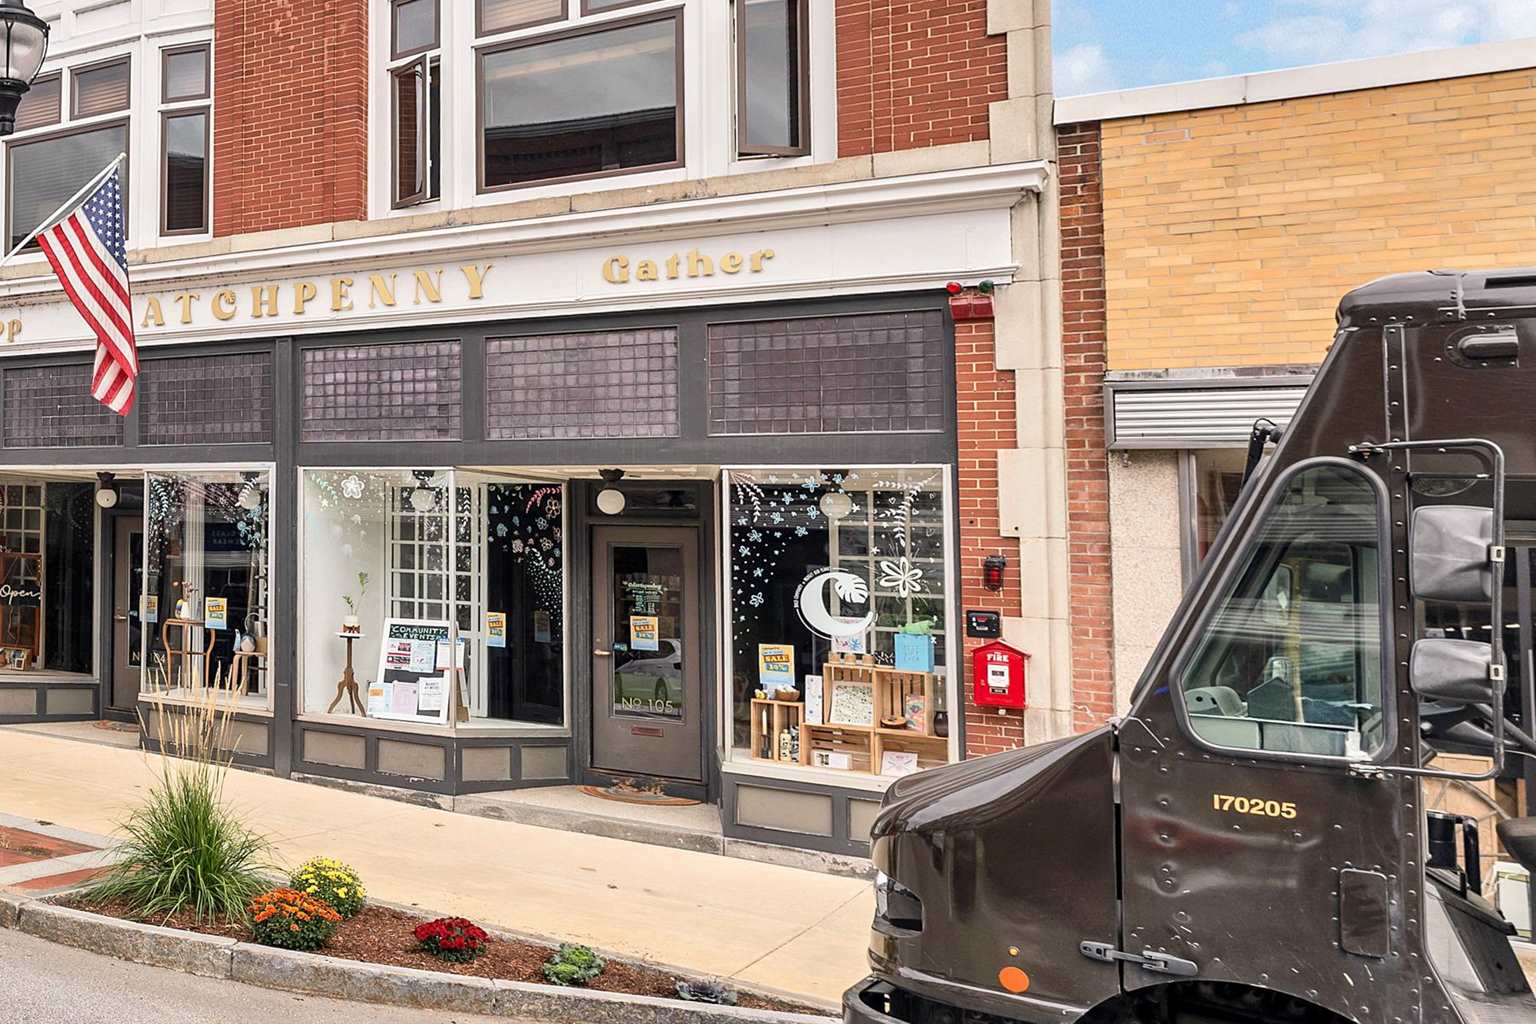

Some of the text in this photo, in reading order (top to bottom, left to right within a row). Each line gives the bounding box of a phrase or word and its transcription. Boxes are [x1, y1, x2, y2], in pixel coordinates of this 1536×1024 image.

[602, 247, 776, 284] Gather
[140, 262, 494, 328] ATCHPENNY
[0, 584, 41, 606] Open
[391, 624, 445, 634] COMMUNITY
[403, 632, 437, 640] EVENTS
[647, 698, 674, 713] 105
